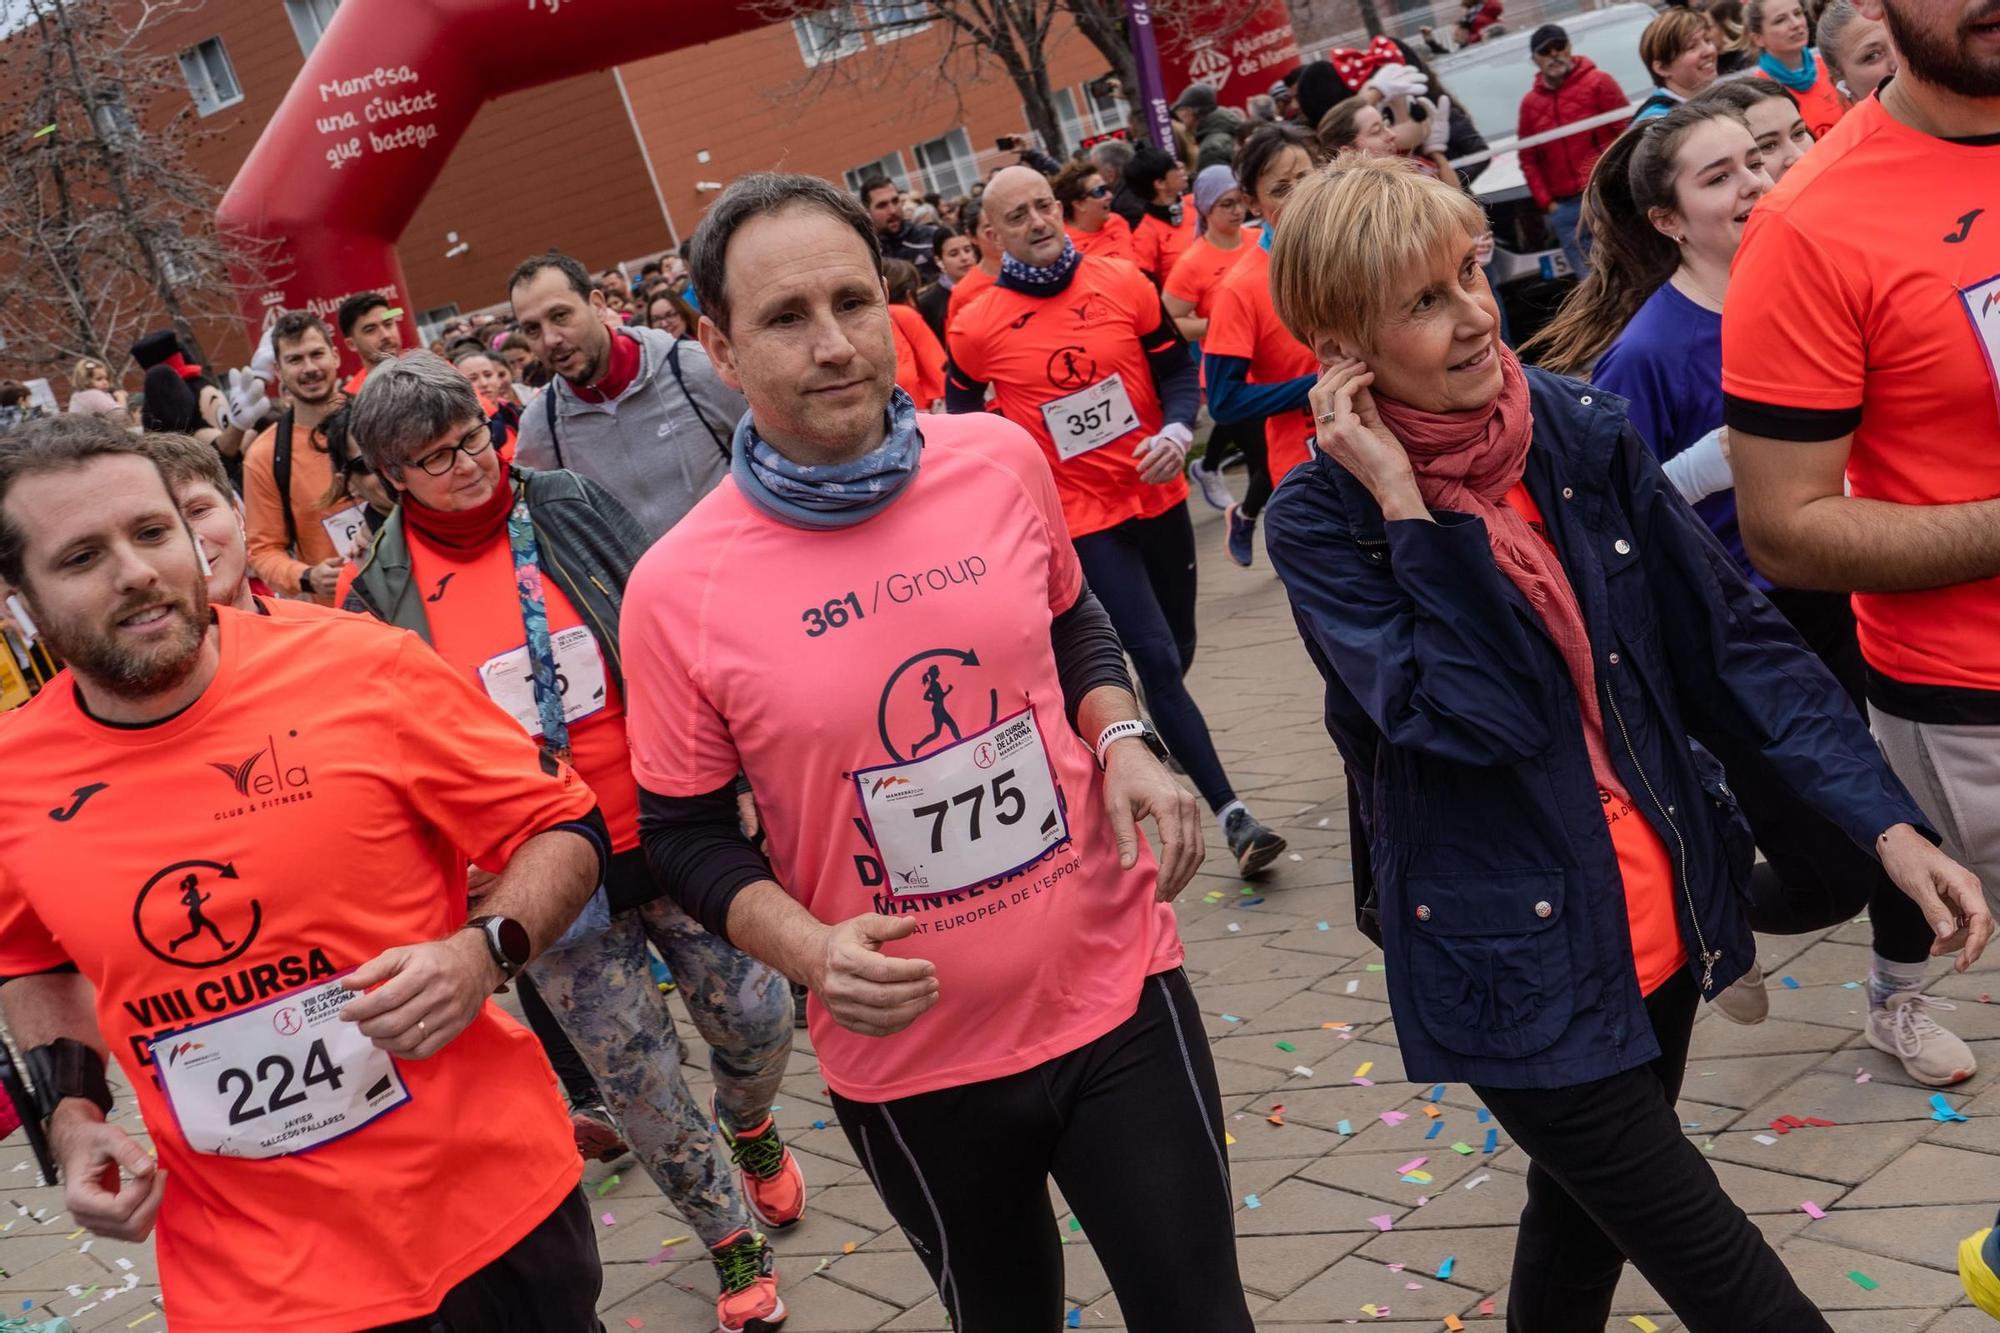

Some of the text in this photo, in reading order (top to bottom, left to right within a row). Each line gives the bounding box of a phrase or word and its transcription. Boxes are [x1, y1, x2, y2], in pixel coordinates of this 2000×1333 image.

[319, 65, 419, 102] Manresa,
[1238, 58, 1259, 76] de
[316, 90, 438, 134] una ciutat
[325, 123, 439, 169] que batega
[1066, 399, 1111, 436] 357
[802, 591, 865, 638] 361
[886, 556, 987, 603] Group
[997, 741, 1006, 751] DE
[1006, 736, 1015, 746] LA
[1014, 726, 1032, 740] DONA
[1005, 720, 1026, 737] CURSA
[214, 791, 313, 820] CLUB & FITNESS
[913, 768, 1026, 854] 775
[935, 900, 1008, 932] EUROPEA
[1011, 888, 1031, 905] DE
[1033, 856, 1081, 893] L'ESPOR
[123, 947, 337, 1028] VIII CURSA
[304, 990, 357, 1017] DE LA DONA
[217, 1037, 345, 1126] 224
[260, 1128, 300, 1148] SALCEDO
[300, 1112, 346, 1135] PALLARES
[284, 1112, 314, 1130] JAVIER
